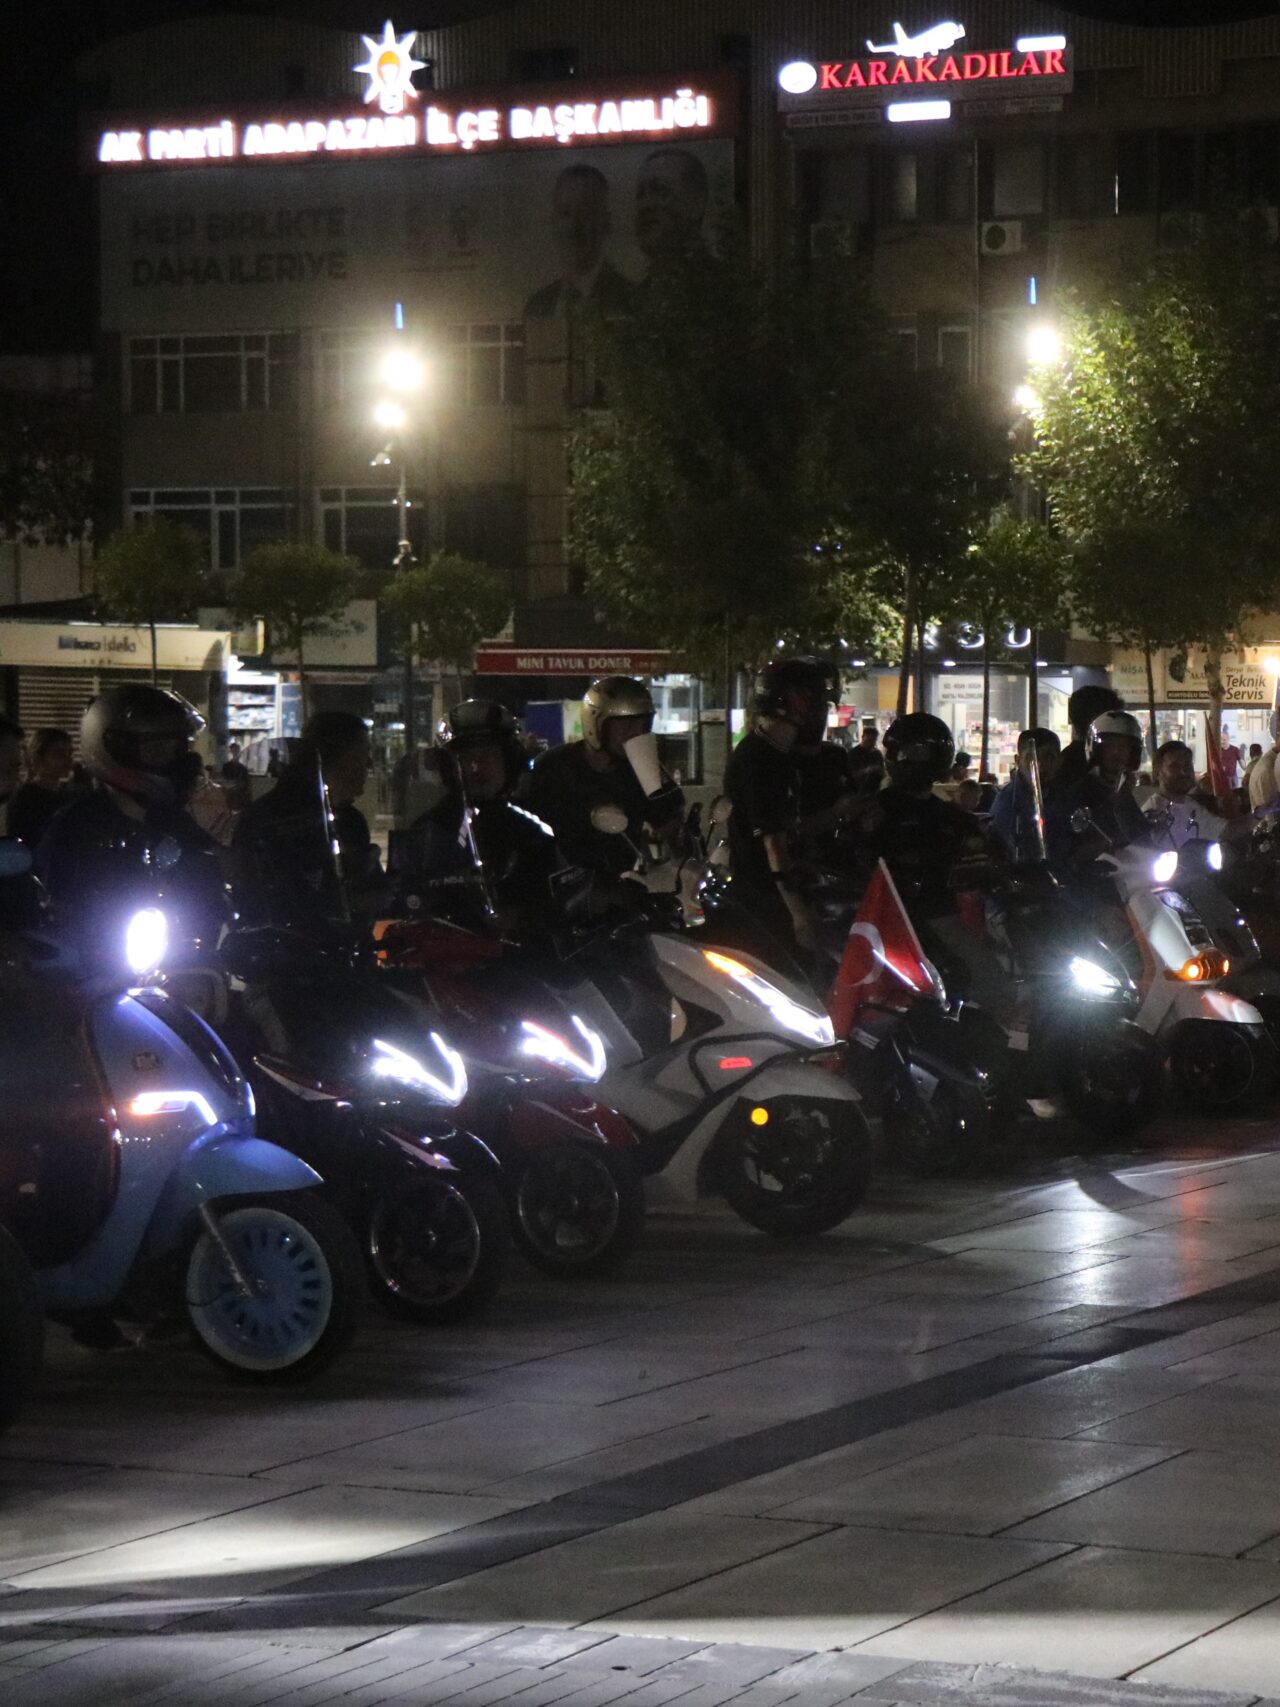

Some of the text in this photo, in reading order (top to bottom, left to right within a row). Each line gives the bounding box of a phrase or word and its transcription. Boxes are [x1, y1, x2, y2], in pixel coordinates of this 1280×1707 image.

[820, 50, 1067, 91] KARAKADILAR
[99, 132, 143, 161] AK
[148, 120, 233, 160] PARTİ
[510, 89, 709, 143] BAŞKANLIĞI
[131, 249, 221, 288] DAHA
[547, 657, 586, 669] TAVUK
[1225, 674, 1266, 688] Teknik
[1225, 687, 1264, 700] Servis
